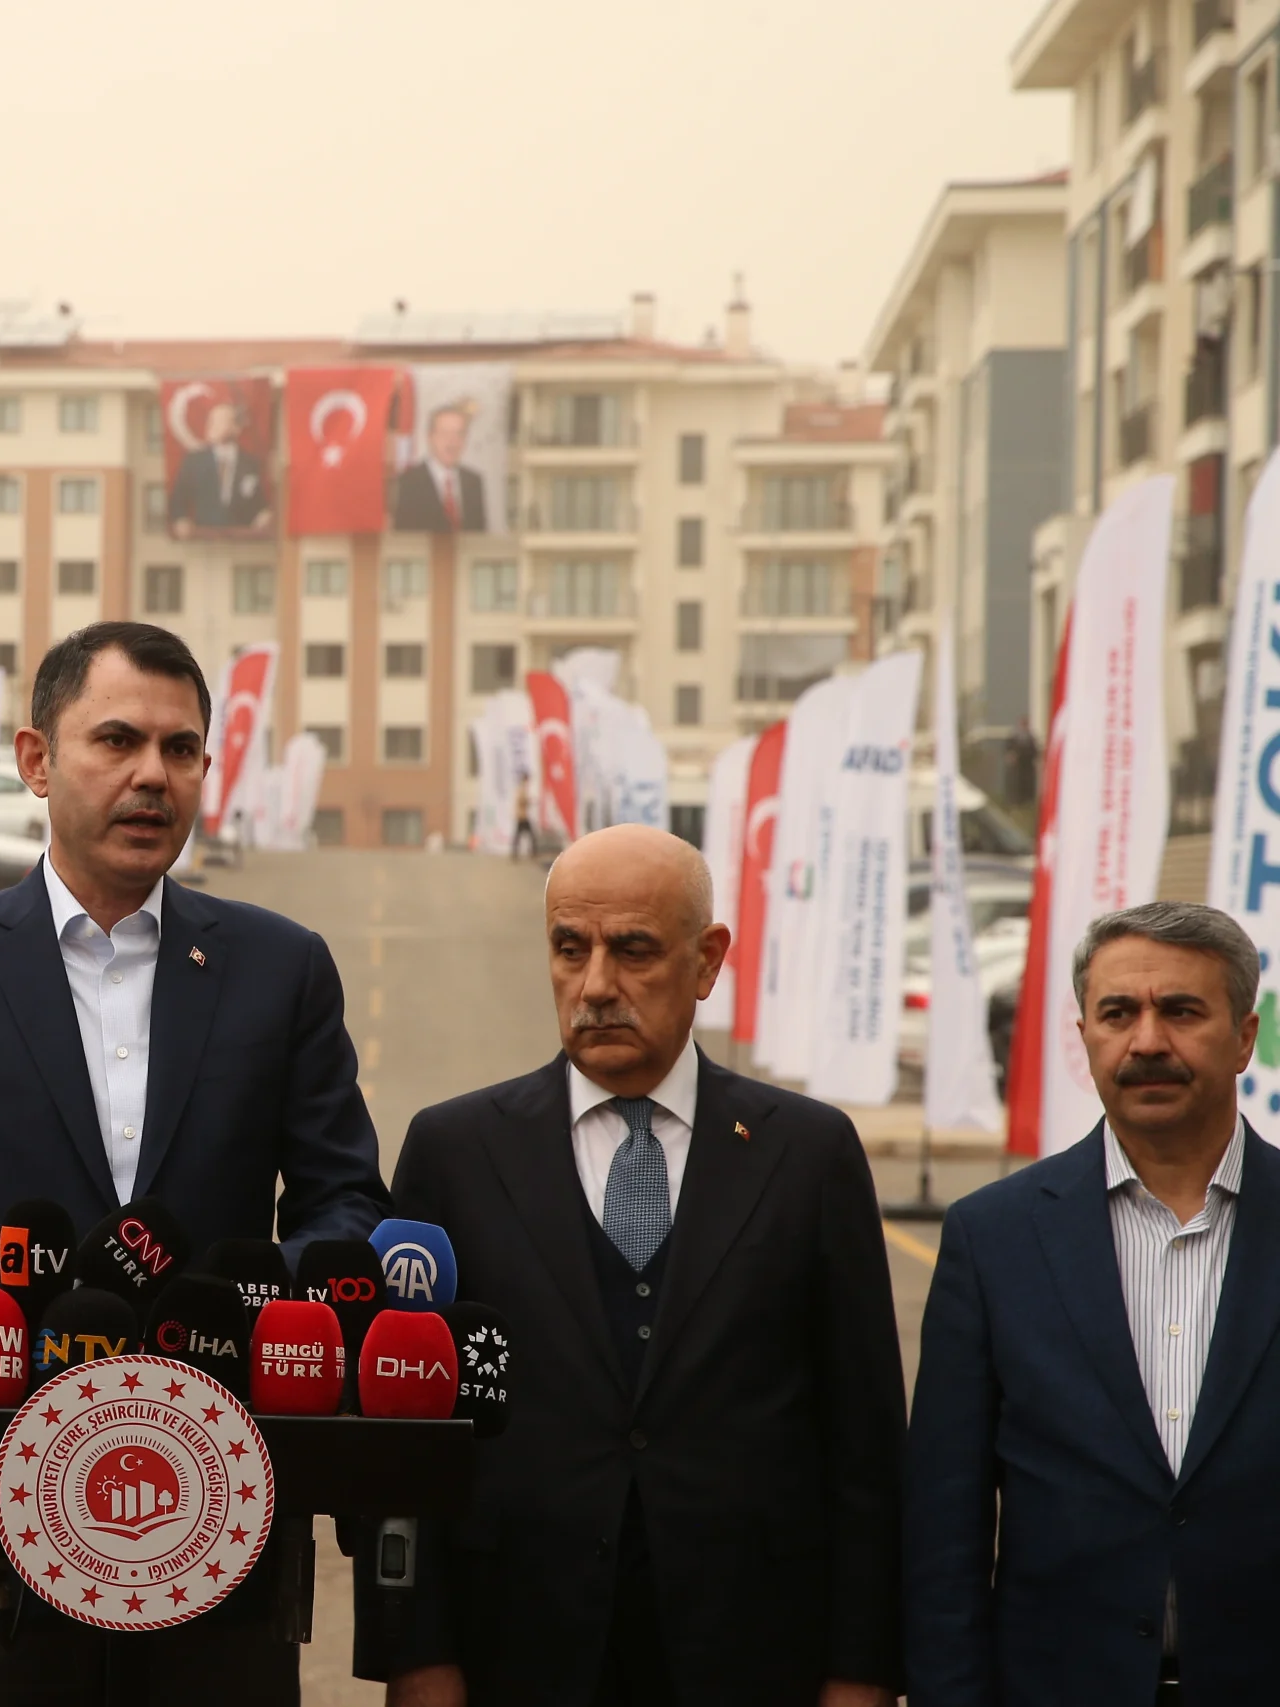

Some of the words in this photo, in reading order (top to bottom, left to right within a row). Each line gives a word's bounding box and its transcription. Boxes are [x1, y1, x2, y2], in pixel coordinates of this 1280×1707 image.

[0, 1241, 68, 1274] atv
[104, 1236, 147, 1287] TÜRK
[120, 1218, 173, 1275] CNN
[236, 1282, 280, 1296] ABER
[42, 1333, 127, 1365] NTV
[261, 1341, 324, 1358] BENGÜ
[261, 1359, 323, 1378] TÜRK
[376, 1356, 451, 1380] DHA
[459, 1382, 507, 1403] STAR
[87, 1402, 161, 1431] ŞEHİRCİLİK
[162, 1410, 180, 1429] VE
[53, 1423, 90, 1460] ÇEVRE,
[177, 1419, 211, 1456] İKLİM
[40, 1459, 73, 1548] CUMHURİYETİ
[201, 1455, 226, 1534] DEĞİŞİKLİĞİ
[68, 1544, 119, 1580] TÜRKİYE
[147, 1531, 211, 1581] BAKANLIĞI
